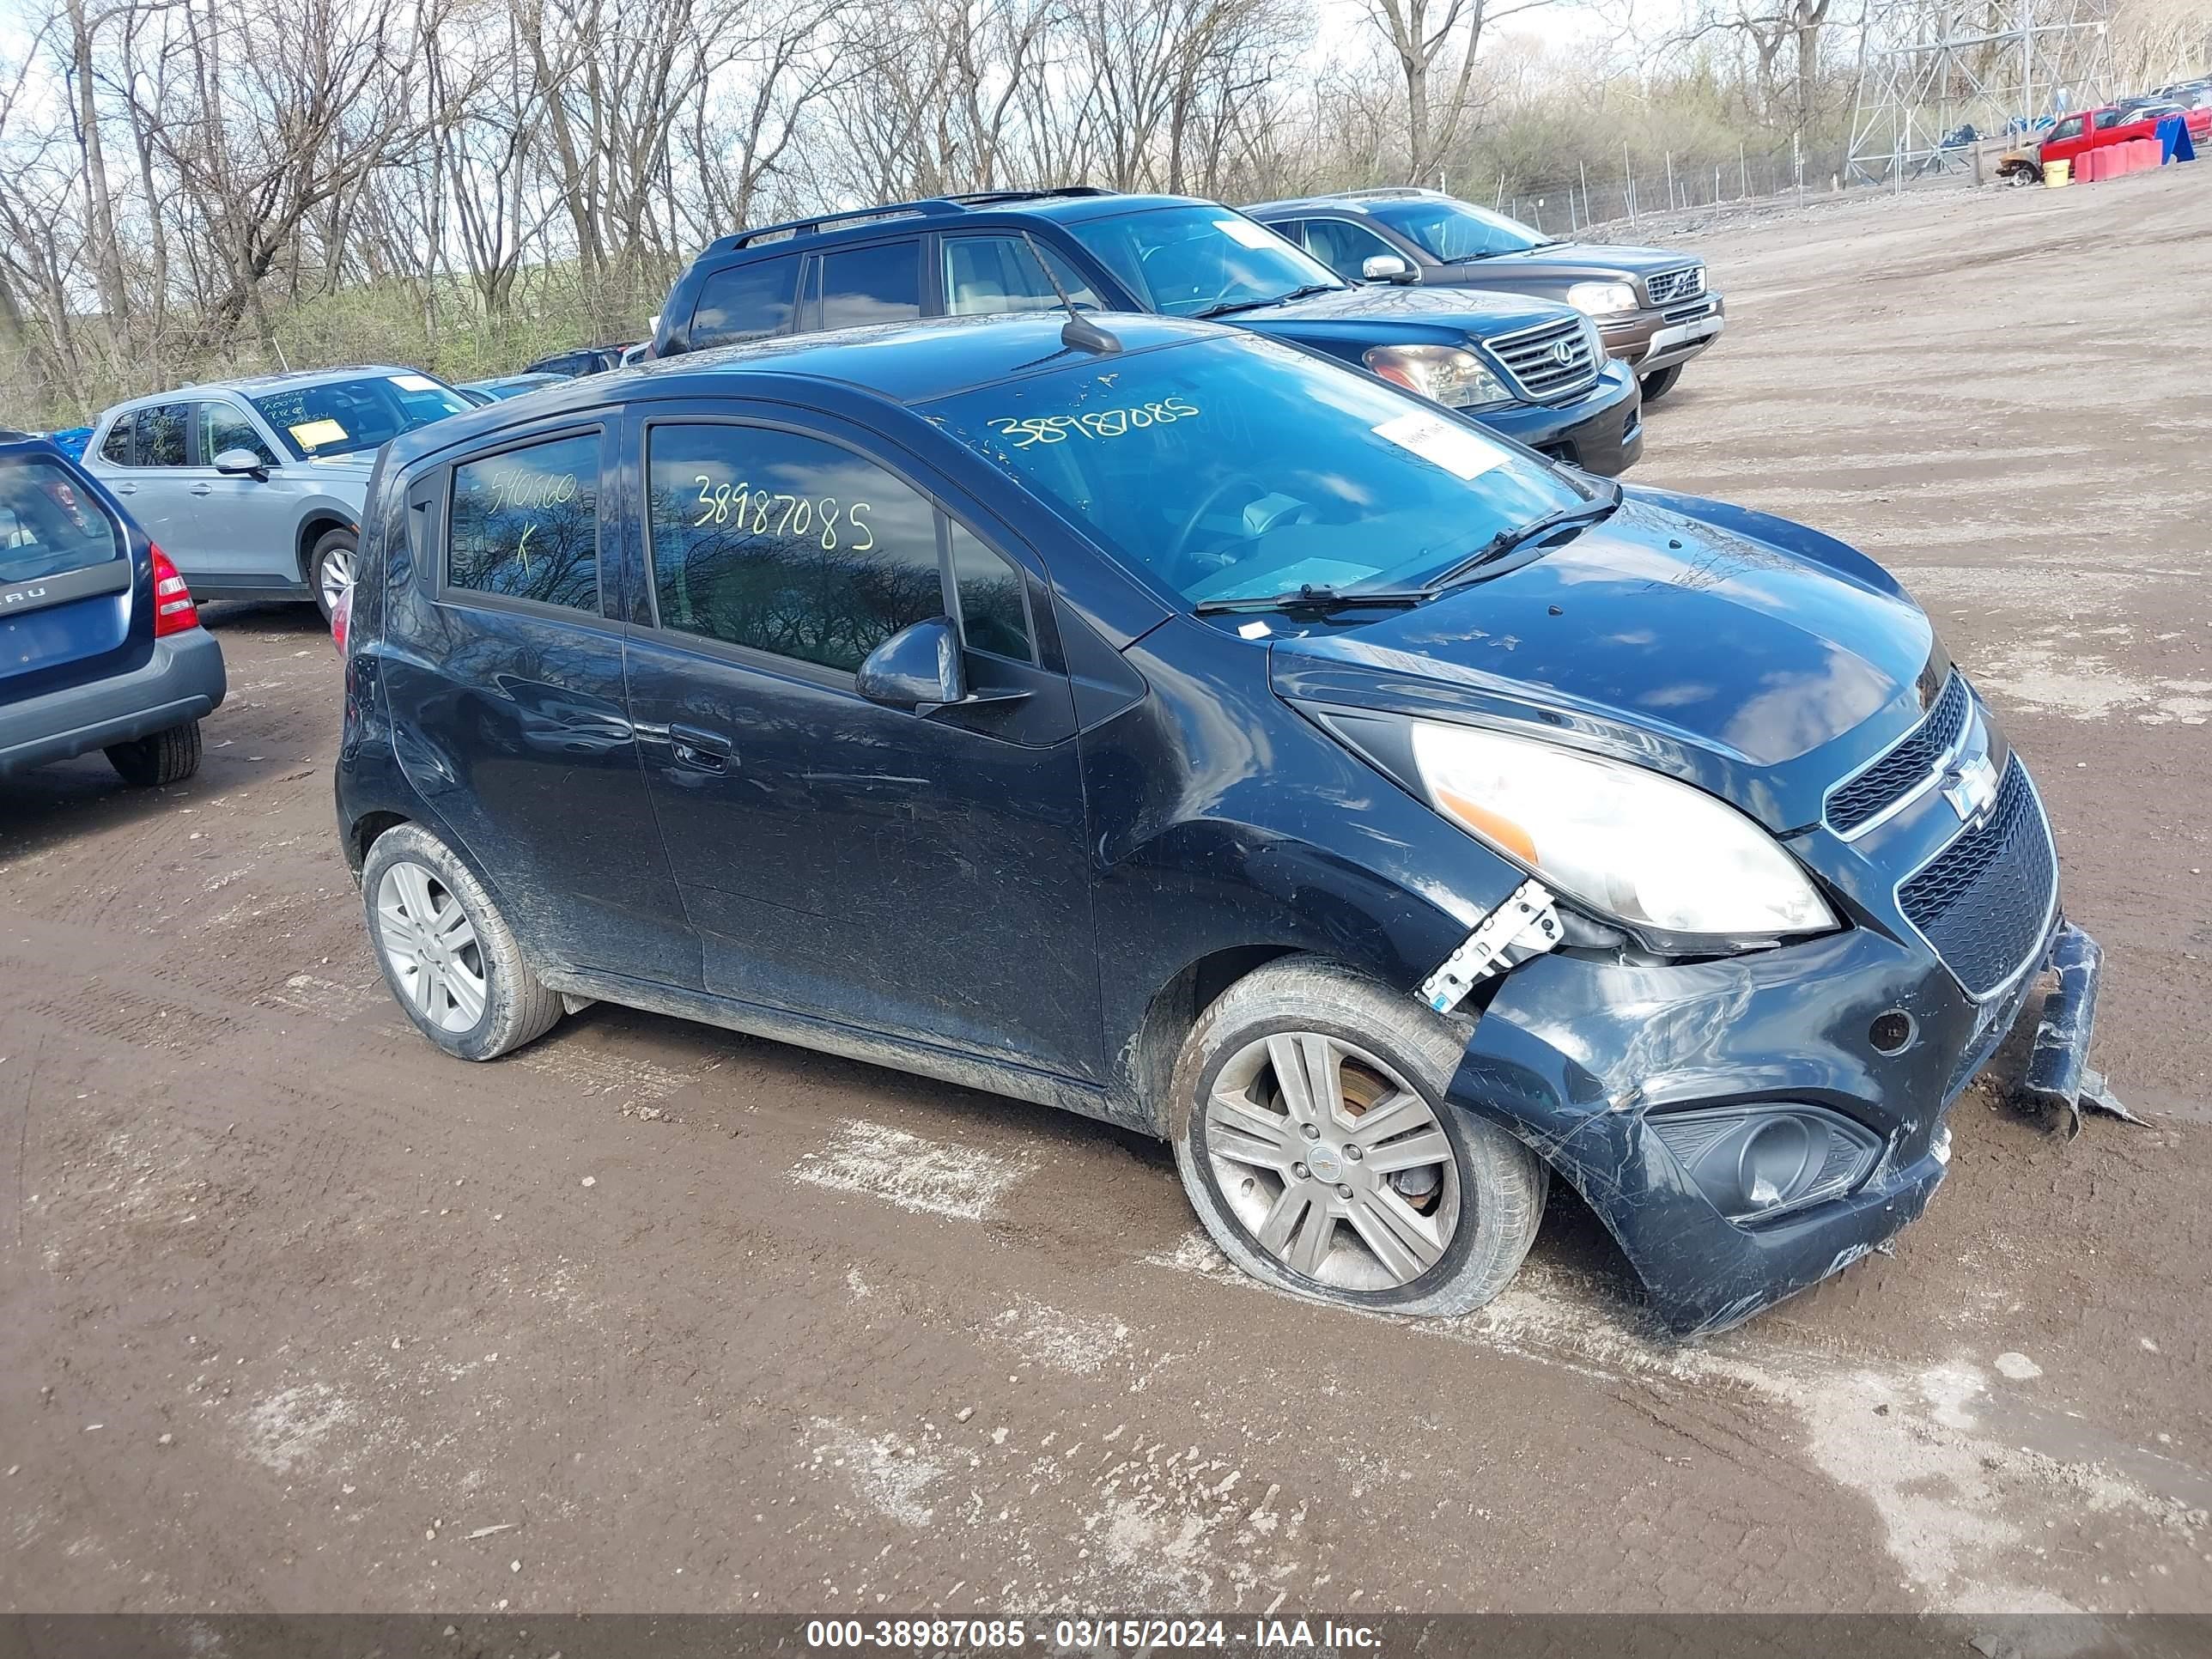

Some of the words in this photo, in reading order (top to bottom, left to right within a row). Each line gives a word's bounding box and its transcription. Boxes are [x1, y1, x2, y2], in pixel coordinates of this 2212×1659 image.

[988, 398, 1200, 447] 38987085
[694, 475, 873, 550] 38987085
[516, 520, 538, 581] K
[0, 587, 46, 605] RU
